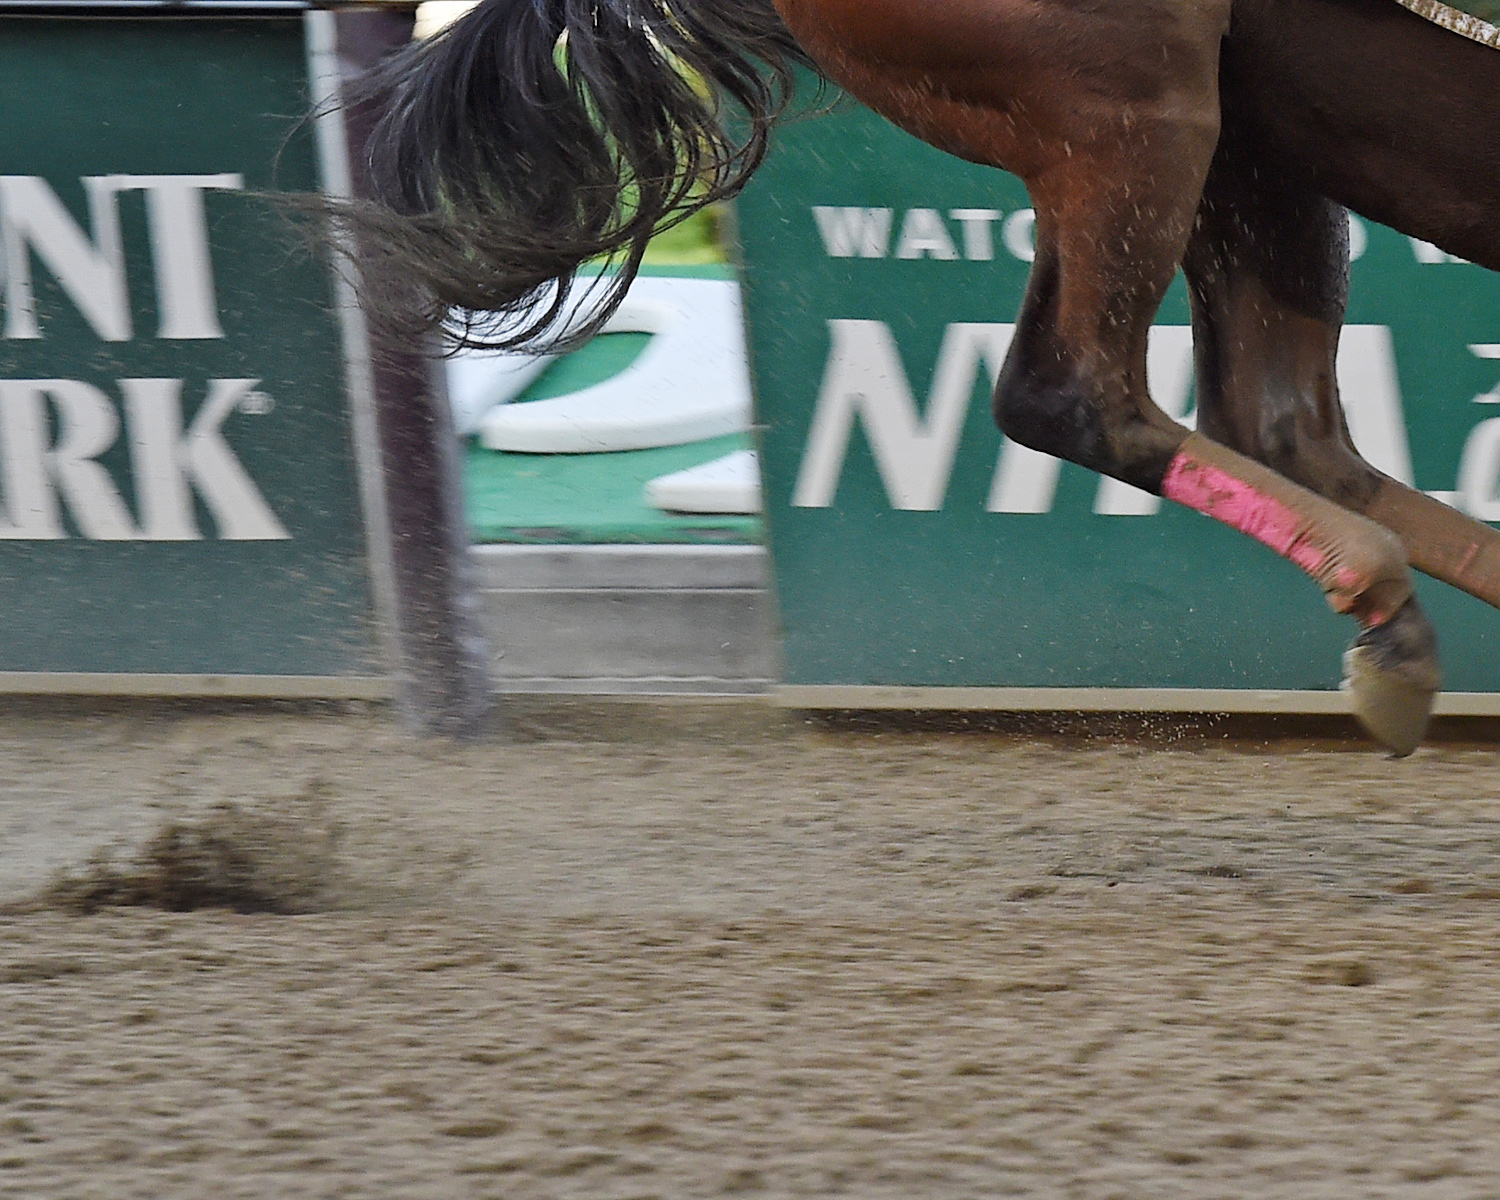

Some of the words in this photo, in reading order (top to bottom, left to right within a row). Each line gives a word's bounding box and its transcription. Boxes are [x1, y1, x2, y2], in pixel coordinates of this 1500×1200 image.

[0, 174, 243, 341] NT
[810, 205, 1038, 263] WATC
[0, 378, 293, 540] RK
